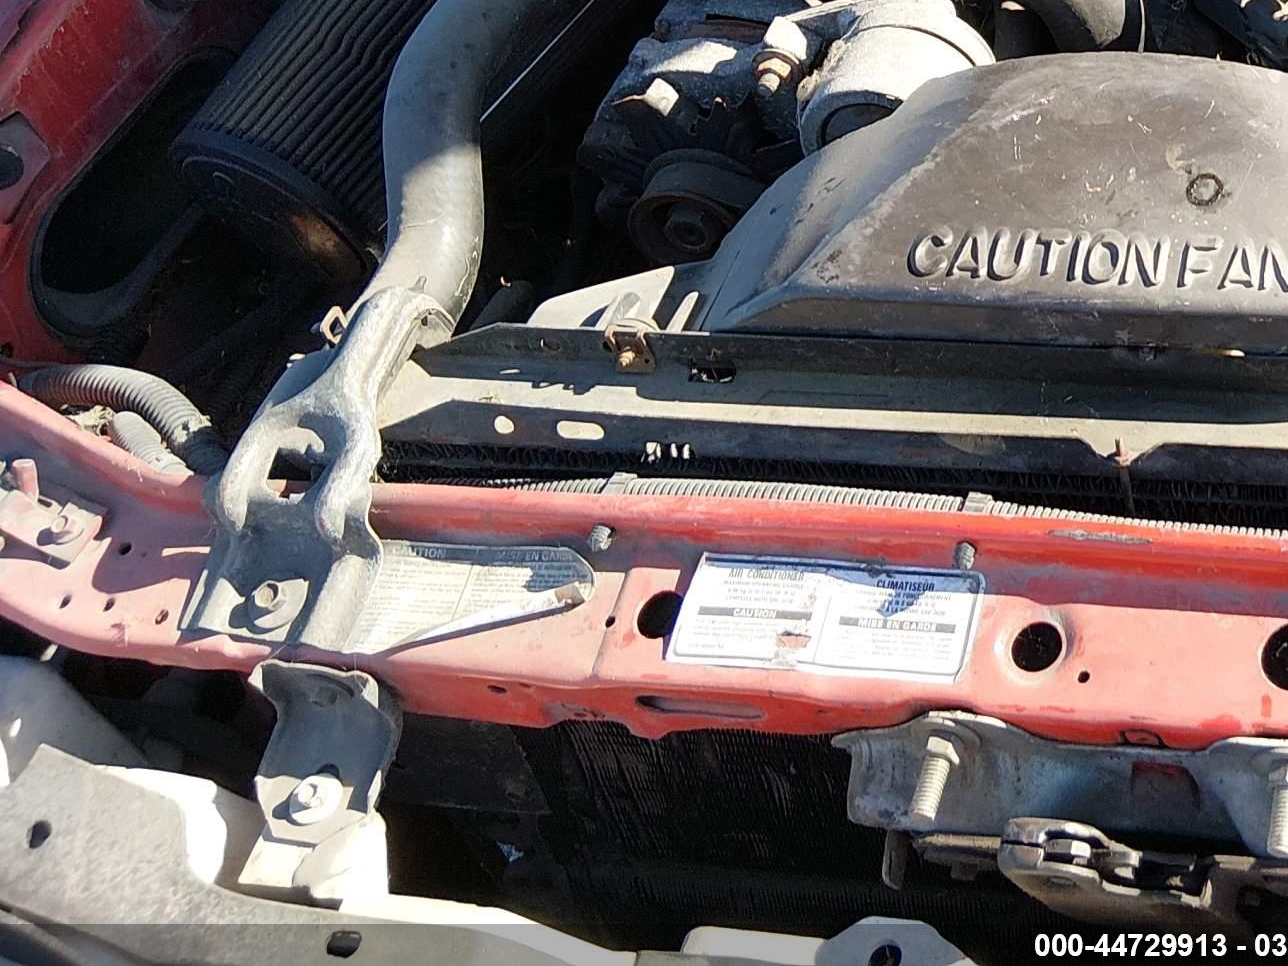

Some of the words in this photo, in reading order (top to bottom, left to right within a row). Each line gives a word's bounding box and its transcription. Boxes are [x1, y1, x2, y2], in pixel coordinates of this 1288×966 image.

[907, 227, 1169, 287] CAUTION
[392, 547, 447, 559] CAUTION
[525, 551, 539, 560] EN
[542, 551, 573, 561] GARDE
[729, 568, 743, 578] AIR
[746, 569, 804, 581] CONDITIONER
[876, 579, 935, 591] CLIMATISEUR
[733, 607, 776, 619] CAUTION
[885, 619, 899, 629] EN
